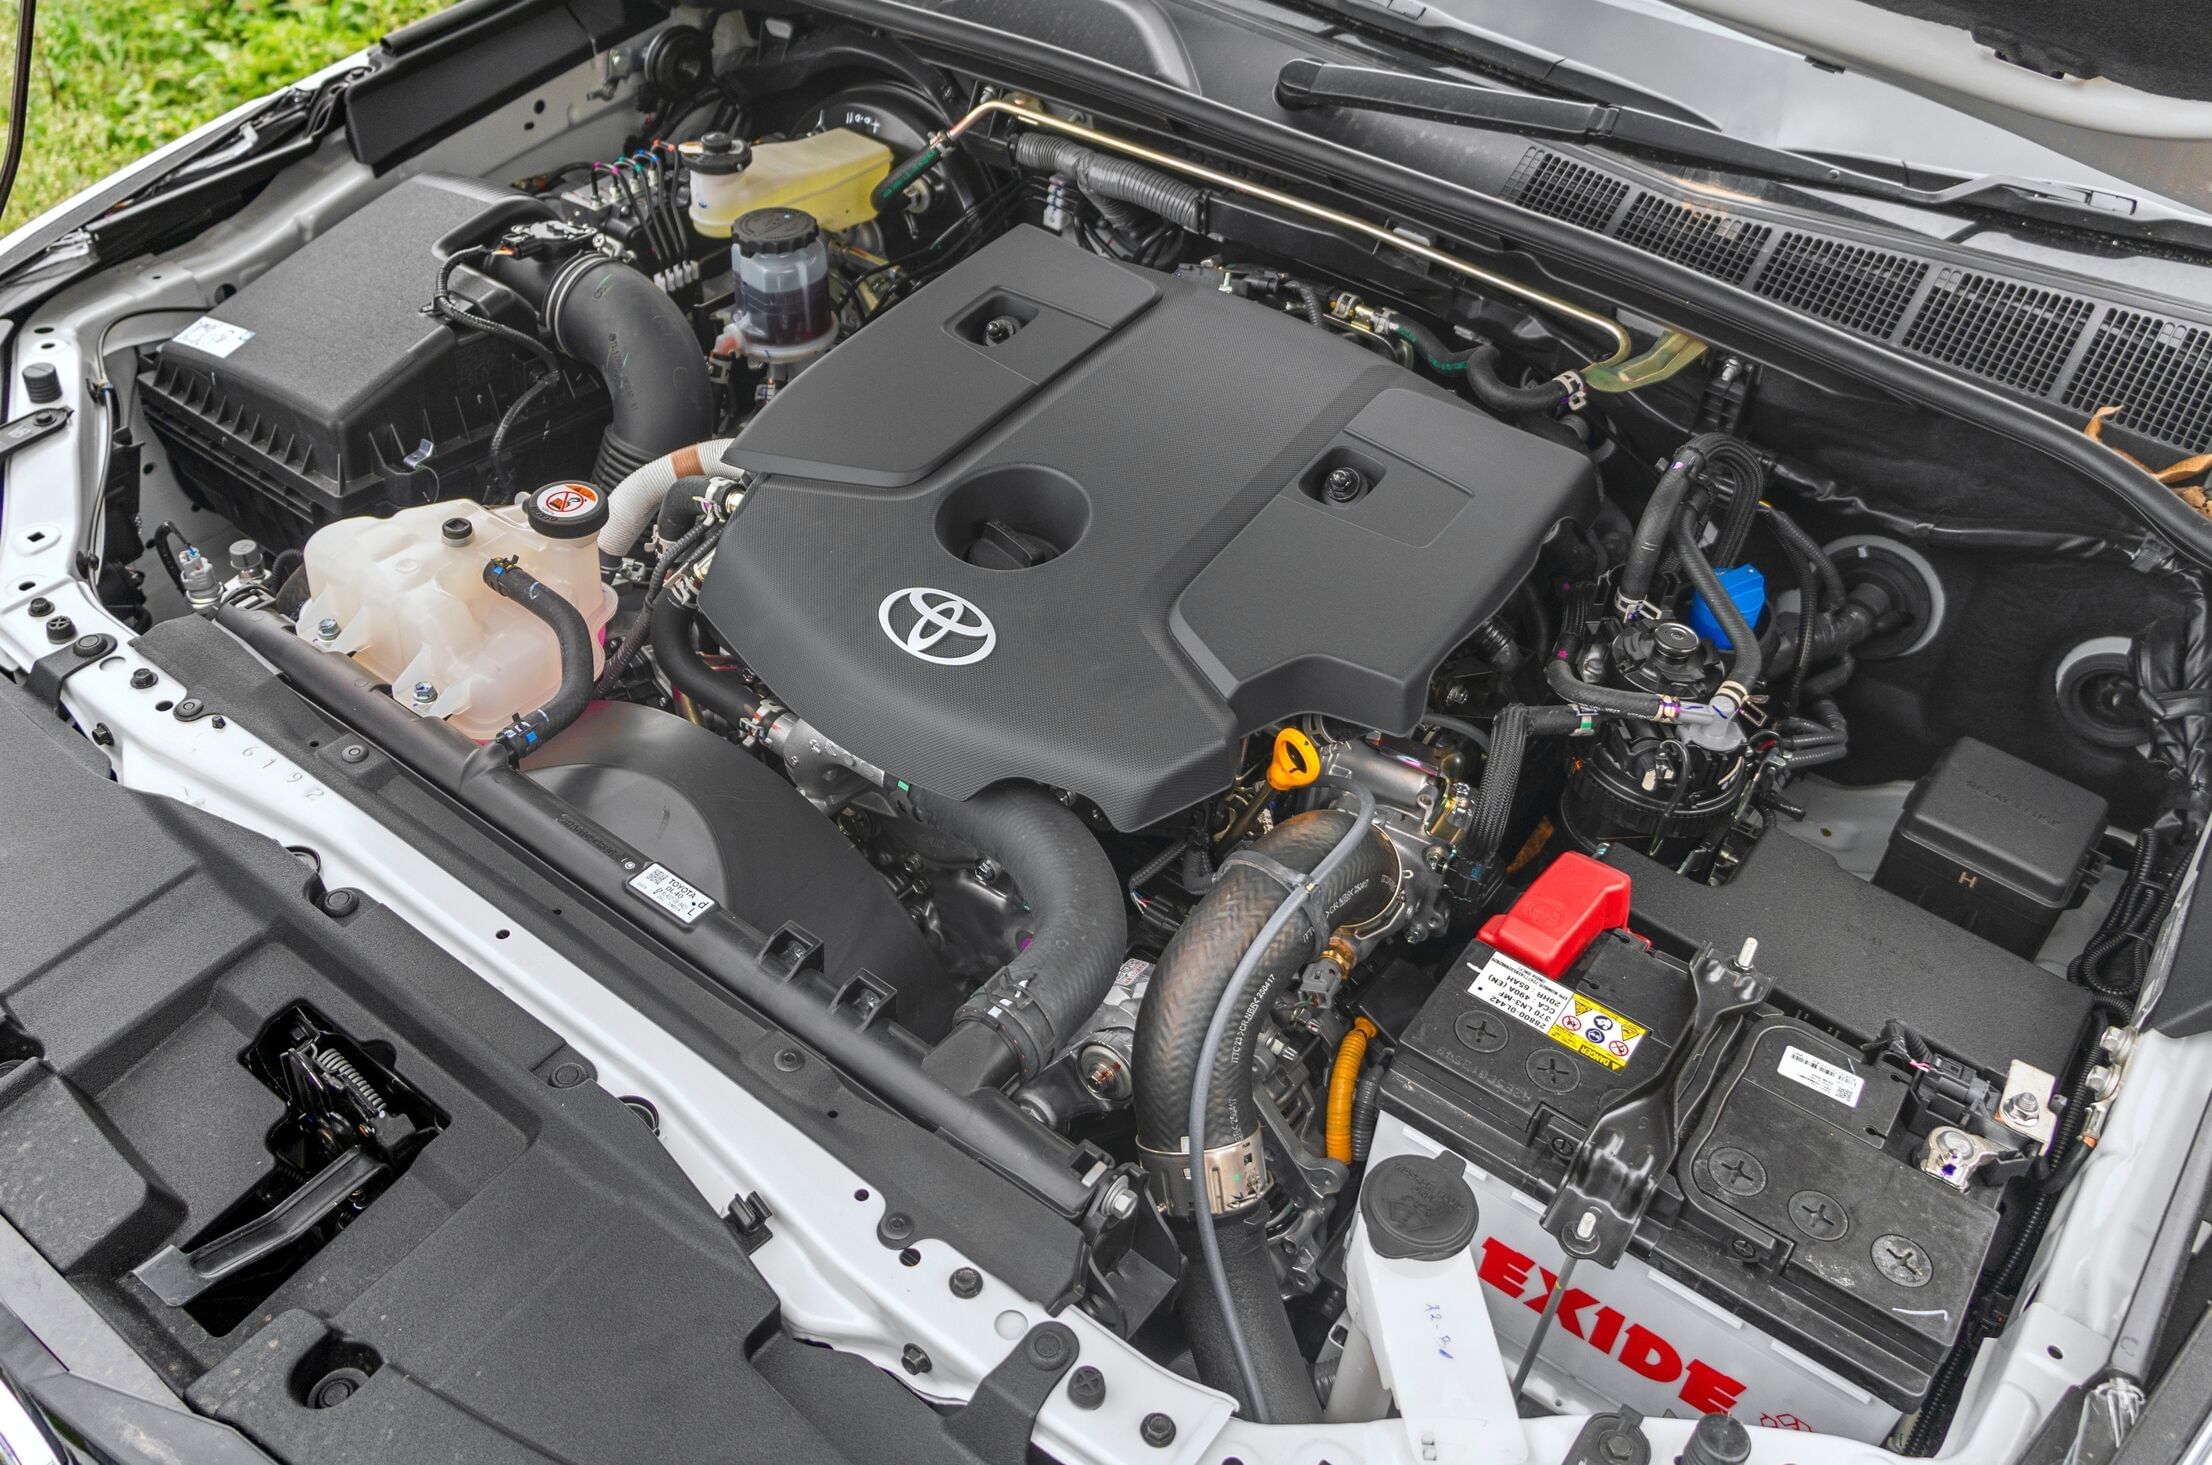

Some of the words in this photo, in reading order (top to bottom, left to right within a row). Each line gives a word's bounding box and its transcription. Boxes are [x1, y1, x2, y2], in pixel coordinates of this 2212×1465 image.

[668, 877, 695, 899] TOYOTA
[1257, 973, 1276, 999] 250417
[1487, 973, 1507, 988] (EN)
[1506, 974, 1529, 990] 65AH
[1497, 989, 1533, 1012] LN3-MF
[1507, 985, 1530, 1001] 490A
[1536, 991, 1560, 1007] 20HR
[1489, 995, 1546, 1029] 28800-0L442
[1533, 1009, 1551, 1022] 370
[1536, 1001, 1555, 1014] CCA
[1579, 1045, 1611, 1066] DANGER
[1479, 1236, 1748, 1417] EXIDE
